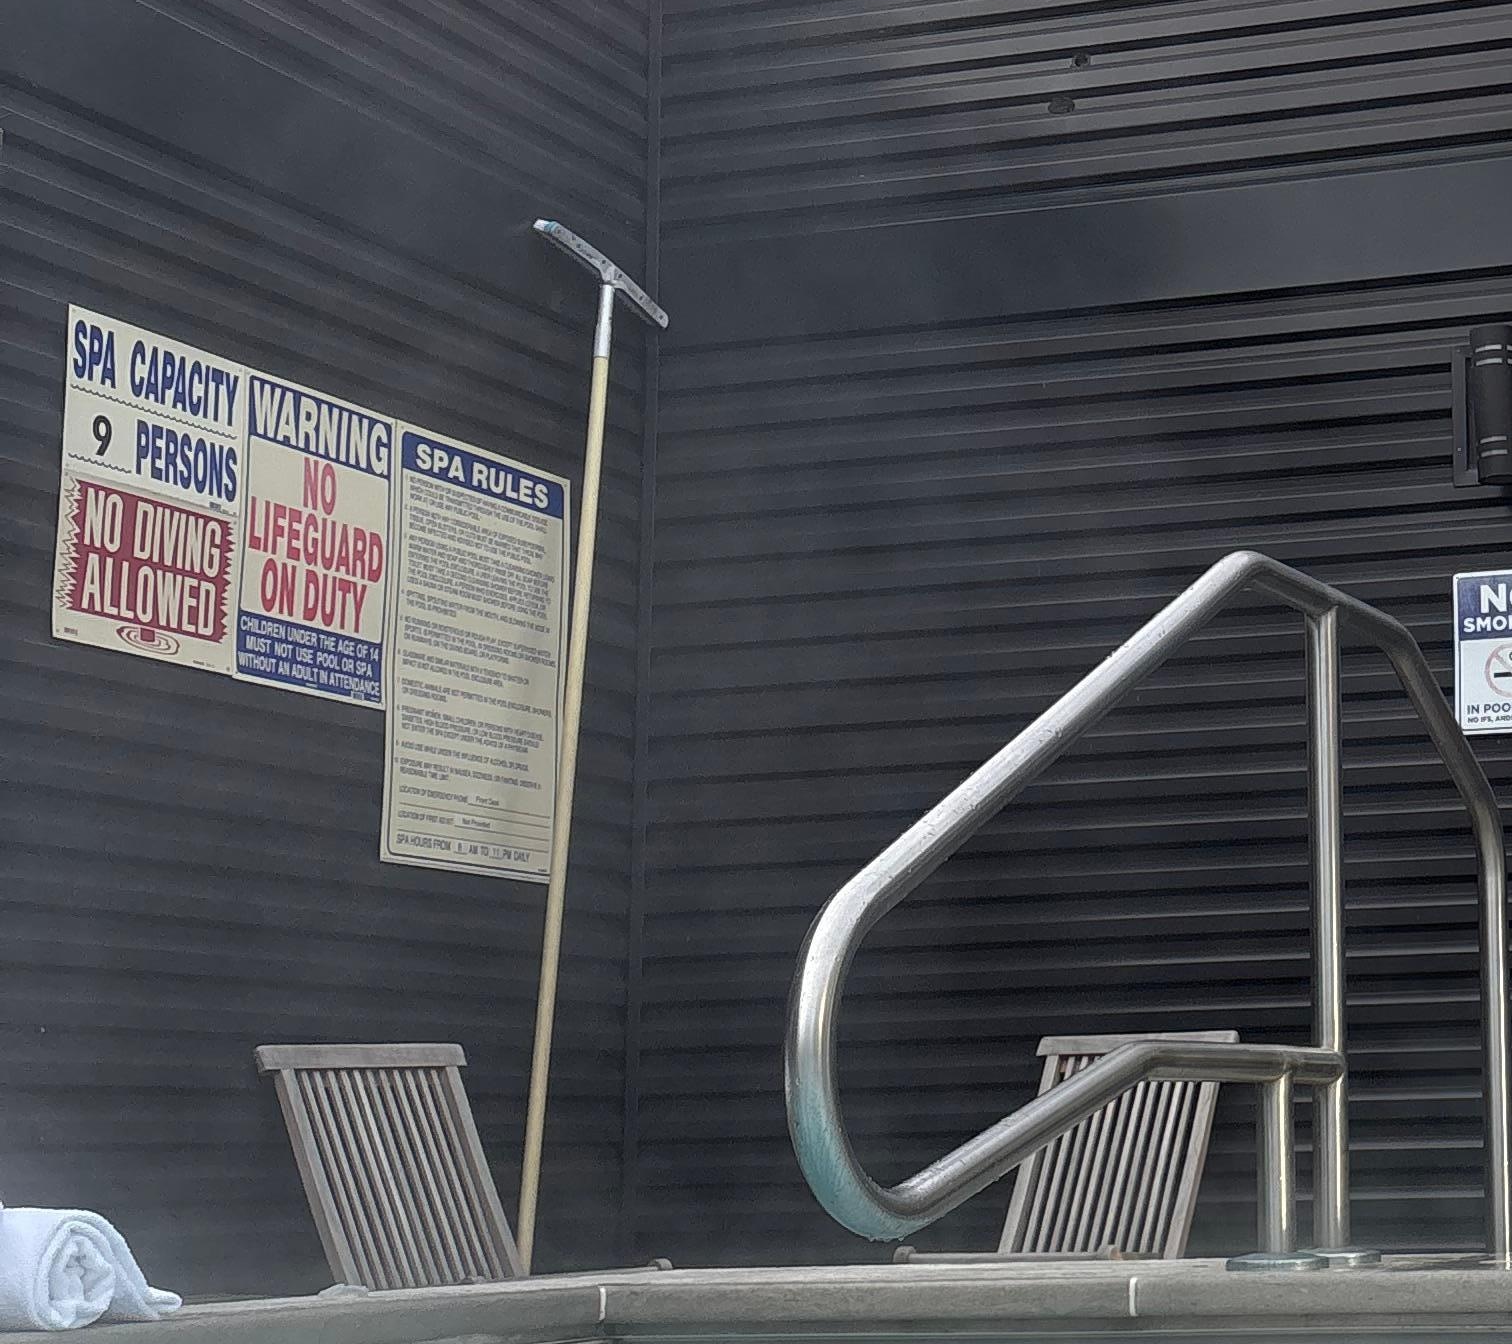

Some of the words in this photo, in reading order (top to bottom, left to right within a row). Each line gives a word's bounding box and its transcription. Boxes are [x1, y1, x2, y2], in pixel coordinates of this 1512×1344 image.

[73, 319, 116, 390] SPA
[130, 340, 240, 427] CAPACITY
[92, 415, 113, 457] 9
[136, 419, 237, 503] PERSONS
[253, 380, 389, 478] WARNING
[303, 457, 336, 516] NO
[415, 443, 466, 484] SPA
[472, 461, 549, 509] RULES
[84, 487, 124, 553] NO
[133, 501, 222, 578] DIVING
[249, 496, 383, 584] LIFEGUARD
[81, 552, 216, 636] ALLOWED
[261, 559, 296, 618] ON
[303, 570, 368, 634] DUTY
[238, 651, 277, 673] WITHOUT
[278, 661, 290, 676] AN
[291, 664, 318, 682] ADULT
[319, 670, 328, 685] IN
[329, 672, 381, 696] ATTENDANCE
[240, 616, 286, 640] CHILDREN
[287, 627, 318, 647] UNDER
[319, 634, 336, 652] THE
[337, 640, 354, 656] AGE
[356, 644, 368, 658] OF
[369, 647, 379, 662] 14
[246, 635, 272, 654] MUST
[274, 642, 293, 659] NOT
[295, 647, 314, 663] USE
[316, 652, 340, 670] POOL
[341, 660, 355, 673] OR
[356, 662, 373, 677] SPA
[1467, 704, 1480, 715] IN
